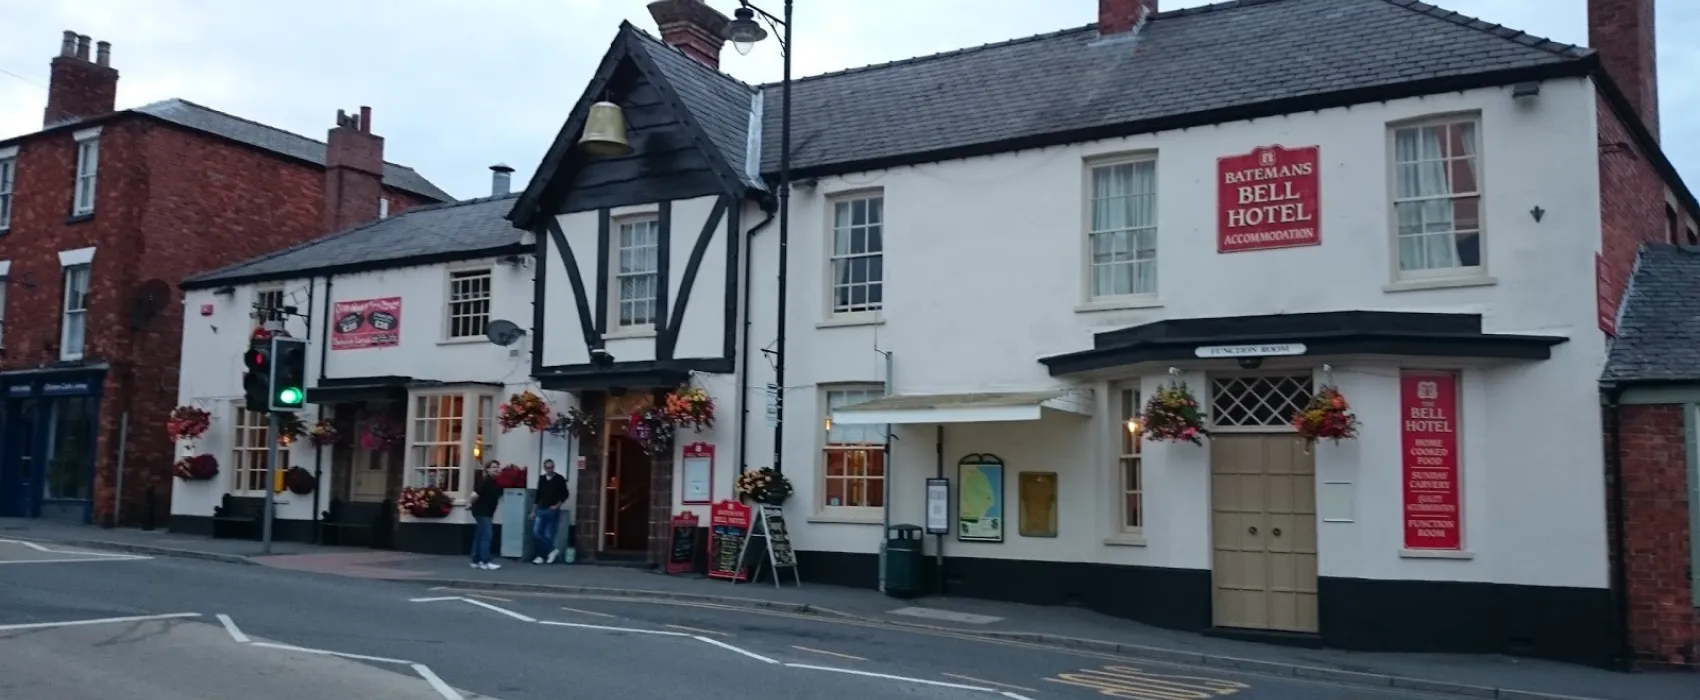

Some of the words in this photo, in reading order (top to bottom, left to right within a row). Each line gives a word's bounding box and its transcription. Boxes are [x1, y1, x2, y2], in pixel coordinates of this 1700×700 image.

[1225, 162, 1312, 184] BATEMANS
[1237, 181, 1300, 205] BELL
[1227, 202, 1312, 228] HOTEL
[1224, 228, 1314, 245] ACCOMMODATION
[1210, 346, 1257, 355] FUNCTION
[1260, 345, 1290, 353] ROOM
[1410, 407, 1446, 419] BELL
[1405, 420, 1453, 433] HOTEL
[1410, 447, 1449, 457] COOKED
[1417, 456, 1444, 466] FOOD
[1411, 471, 1448, 480] SUNDAY
[1409, 480, 1450, 489] CARVERY
[1408, 519, 1455, 528] FUNCTION
[1417, 528, 1446, 537] ROOM
